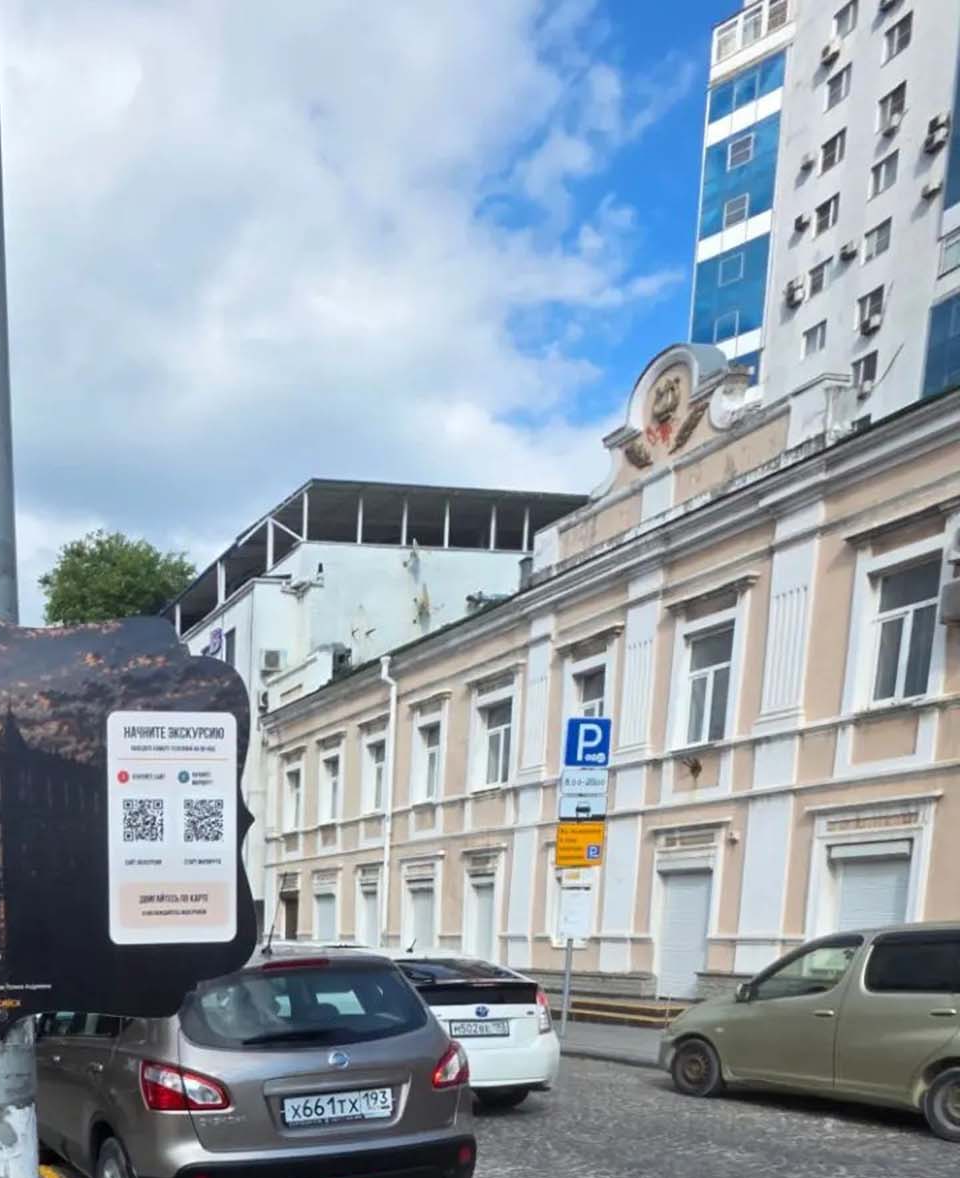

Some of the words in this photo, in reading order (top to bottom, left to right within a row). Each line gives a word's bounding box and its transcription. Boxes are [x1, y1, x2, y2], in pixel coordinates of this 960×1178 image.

[123, 726, 166, 739] НАЧНИТЕ
[167, 726, 225, 739] ЭКСКУРСИЮ
[290, 1096, 359, 1119] Х661ТХ
[361, 1090, 388, 1106] 193
